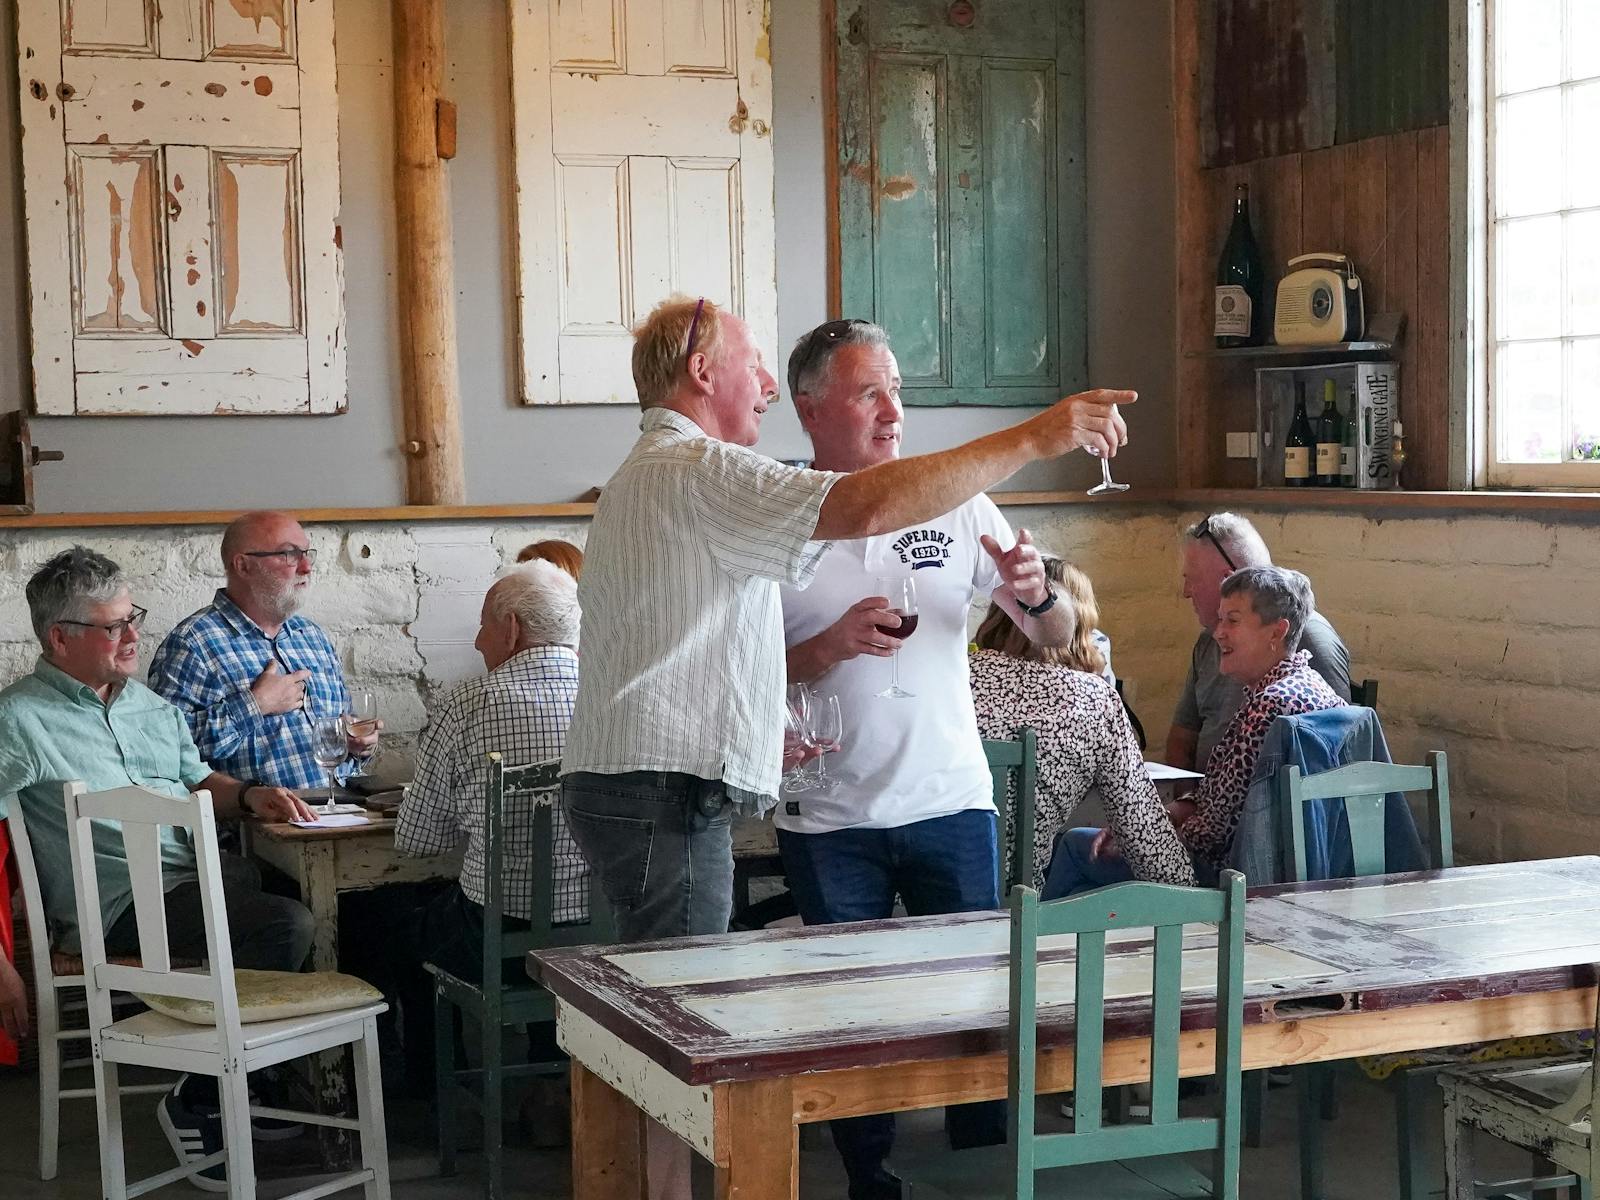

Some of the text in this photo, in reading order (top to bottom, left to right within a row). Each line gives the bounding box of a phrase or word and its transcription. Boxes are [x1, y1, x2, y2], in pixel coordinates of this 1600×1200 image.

[1366, 374, 1390, 479] SWINGING GATE
[892, 529, 954, 554] SUPERDRY
